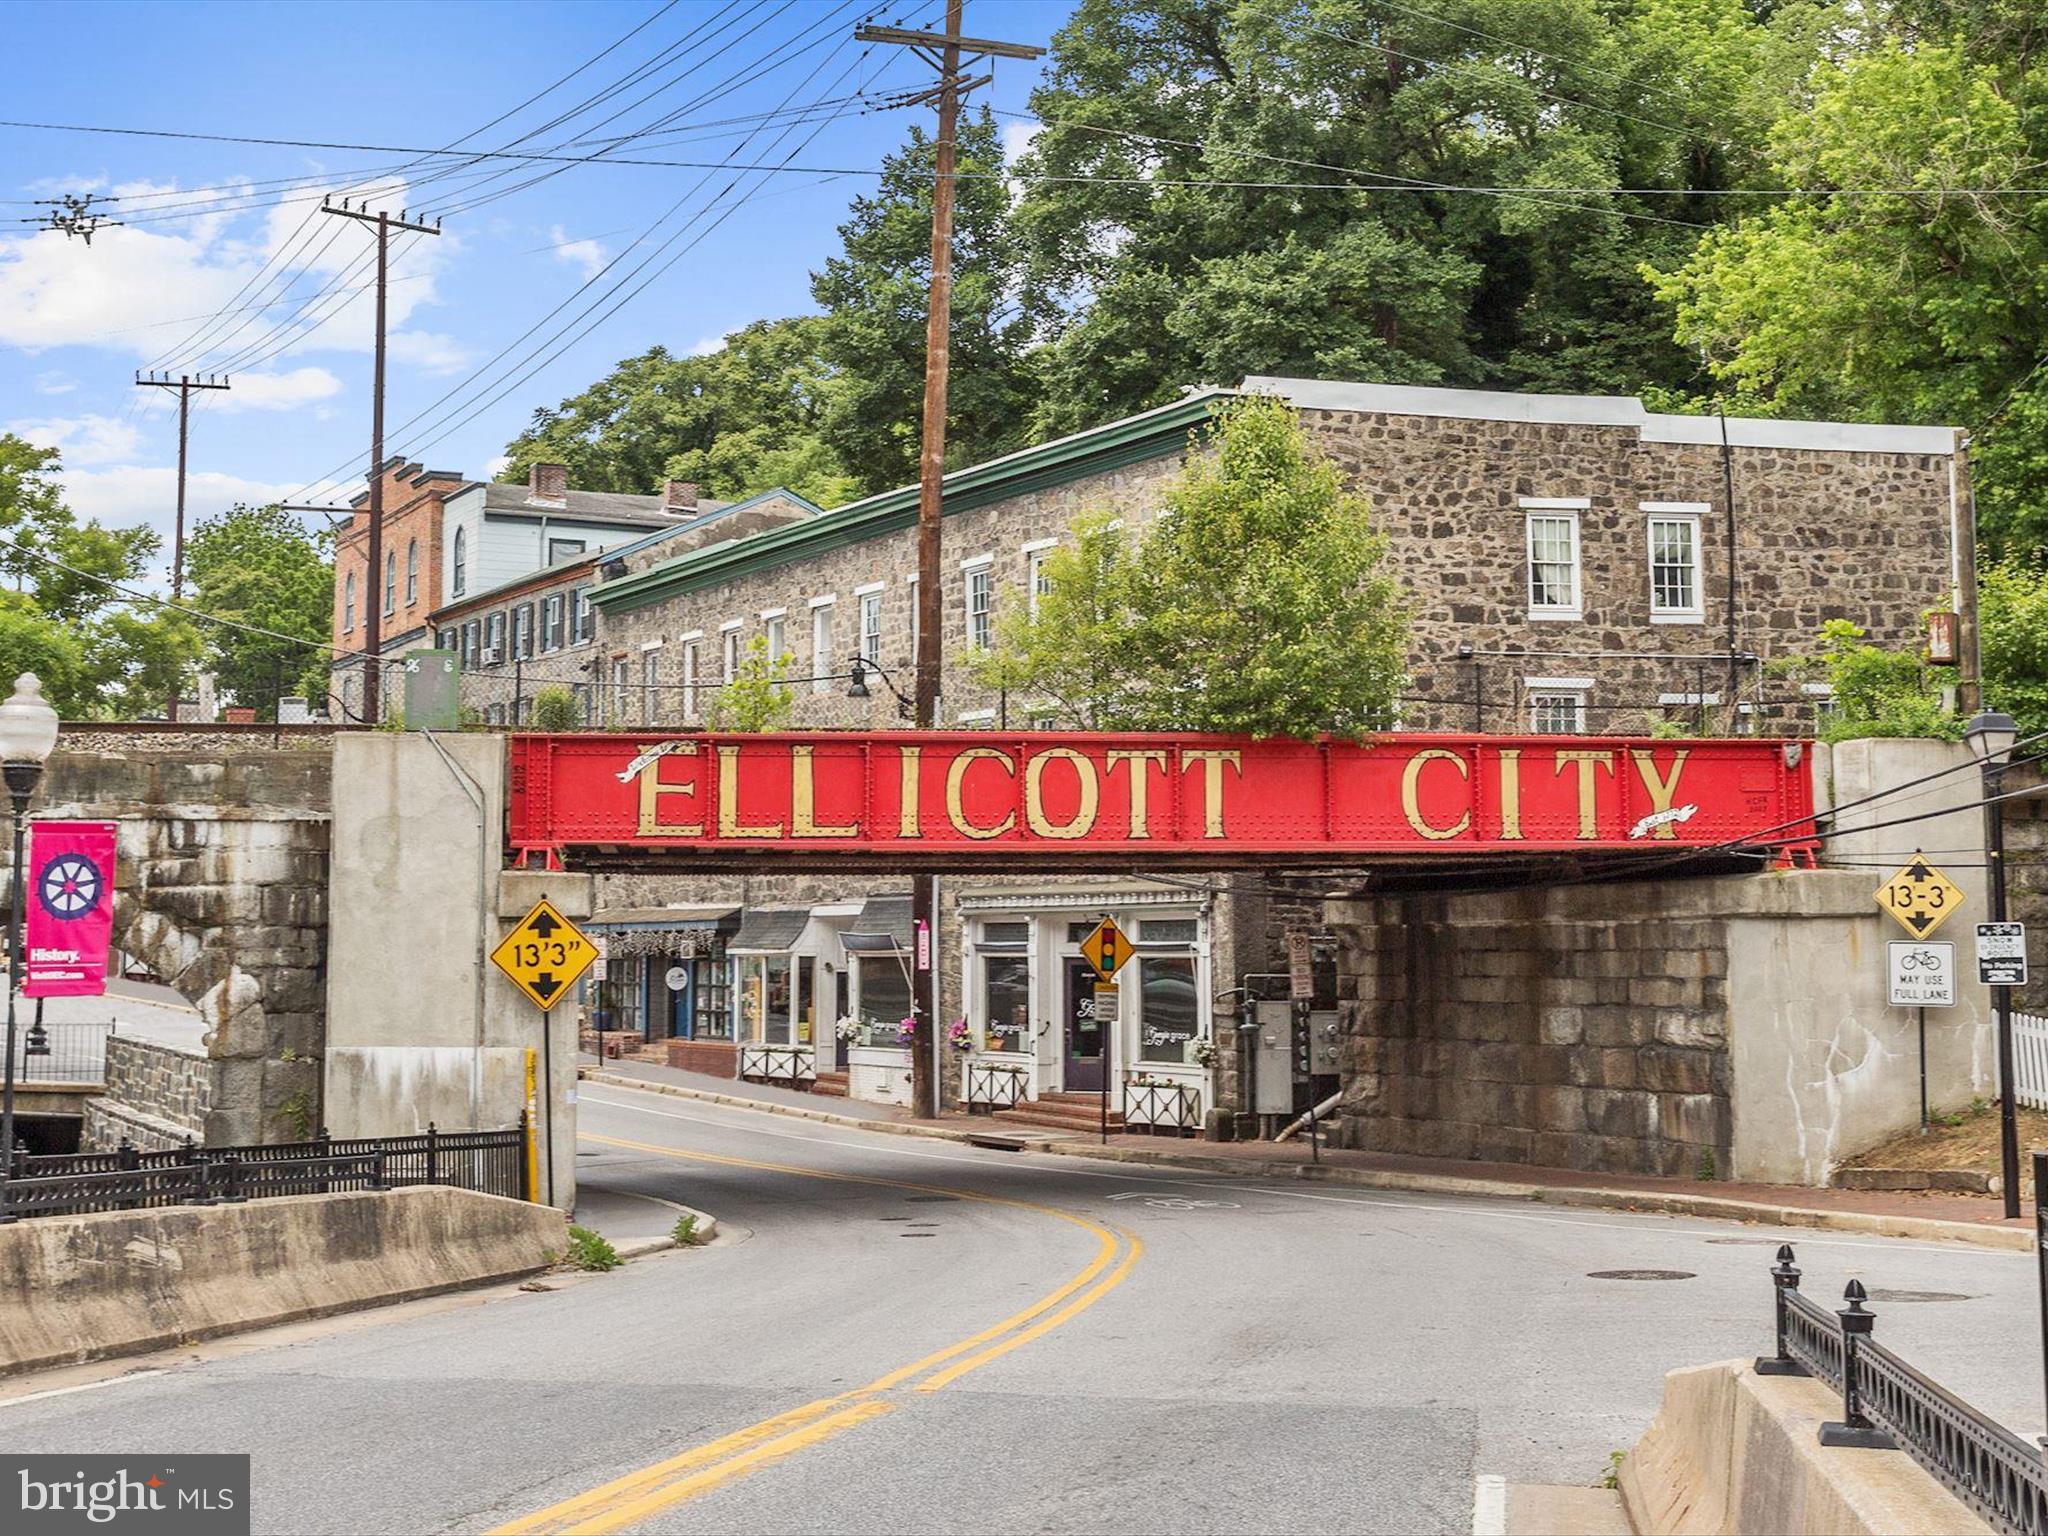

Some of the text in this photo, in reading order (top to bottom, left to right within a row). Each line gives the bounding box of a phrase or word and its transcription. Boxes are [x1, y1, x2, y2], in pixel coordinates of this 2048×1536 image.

[635, 742, 1690, 841] ELLICOTT CITY
[1900, 975, 1944, 985] MAY USE
[1894, 989, 1949, 1000] FULL LANE
